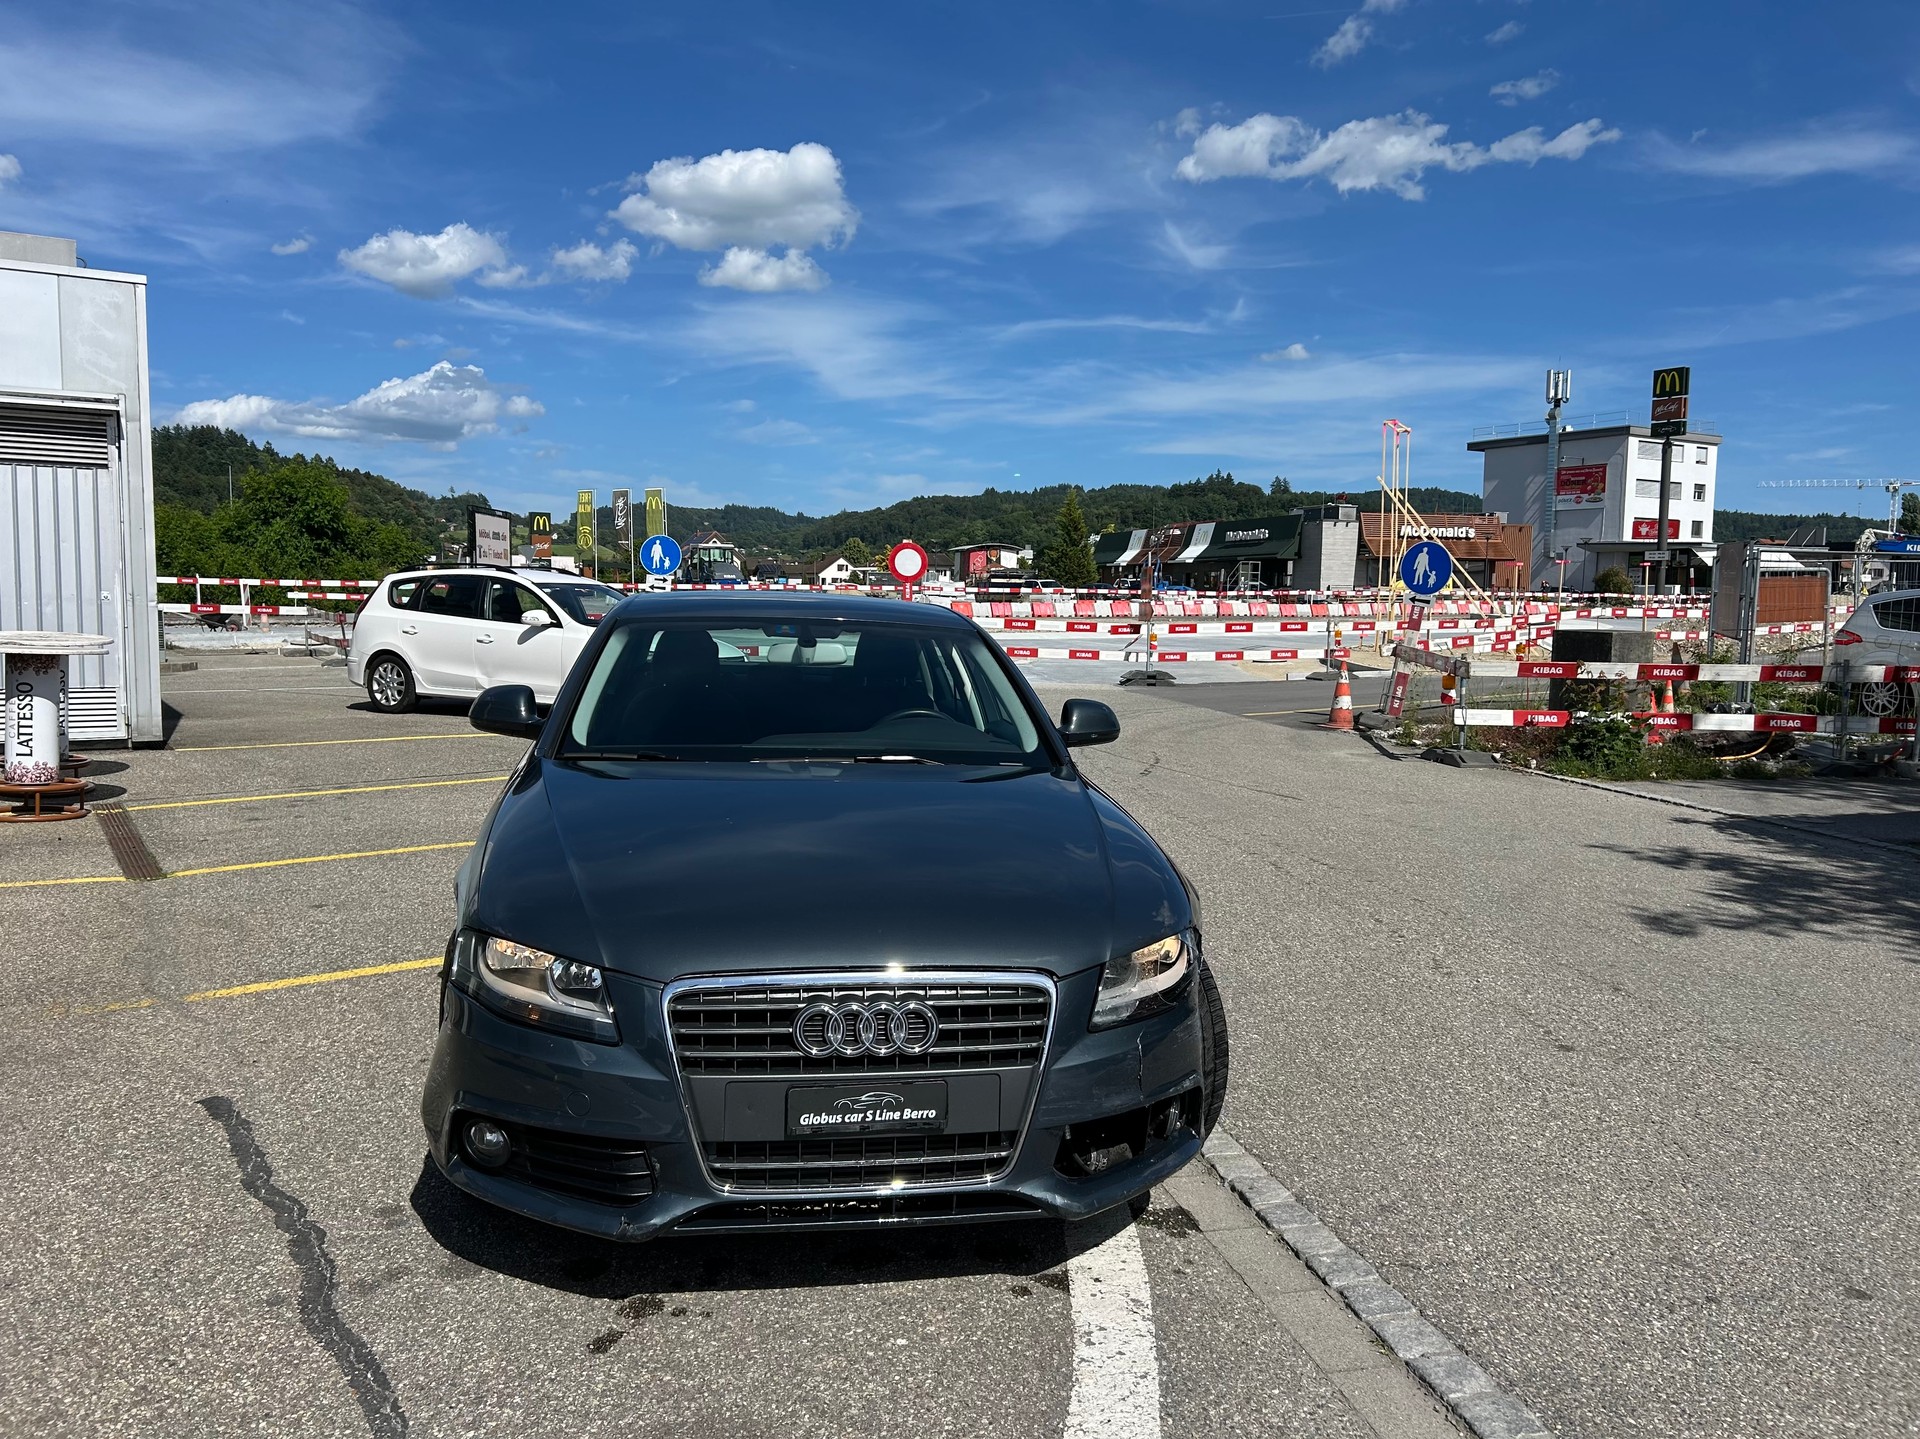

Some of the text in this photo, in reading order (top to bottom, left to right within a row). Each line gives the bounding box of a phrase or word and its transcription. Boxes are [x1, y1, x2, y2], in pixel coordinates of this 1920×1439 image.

[1400, 525, 1475, 538] McDonald's
[1532, 666, 1563, 674] KIBAG
[1653, 668, 1684, 676] KIBAG
[1775, 670, 1807, 678] KIBAG
[1393, 686, 1403, 708] KIAG
[16, 682, 33, 757] LATTESSO
[1527, 714, 1558, 723] KIBAG
[1769, 719, 1801, 727] KIBAG
[800, 1108, 937, 1125] Globus car S Line Berro
